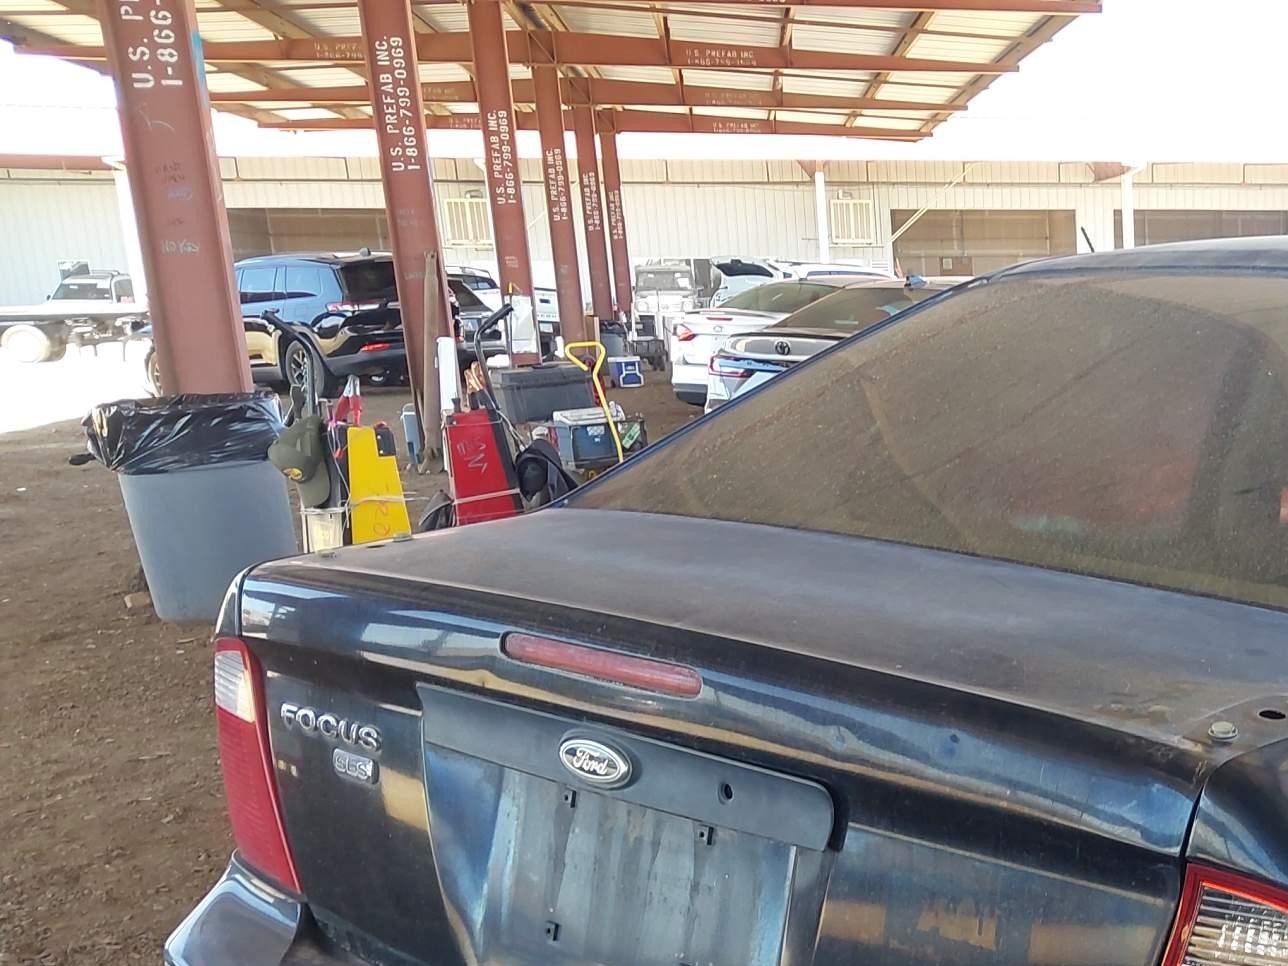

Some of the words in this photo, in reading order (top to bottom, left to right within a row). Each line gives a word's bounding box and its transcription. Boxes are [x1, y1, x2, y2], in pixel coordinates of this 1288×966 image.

[120, 0, 144, 20] P
[127, 38, 155, 88] U.S.
[375, 36, 390, 66] INC.
[380, 73, 399, 134] PREFAB
[389, 36, 421, 170] 1-866-799-0969
[488, 110, 498, 131] INC.
[390, 142, 405, 172] U.S.
[490, 136, 503, 178] PREFAB
[498, 110, 517, 204] 1-866-799-0969
[496, 184, 506, 205] U.S.
[547, 168, 558, 201] PREFAB
[281, 703, 382, 752] FOCUS
[572, 747, 609, 775] Ford
